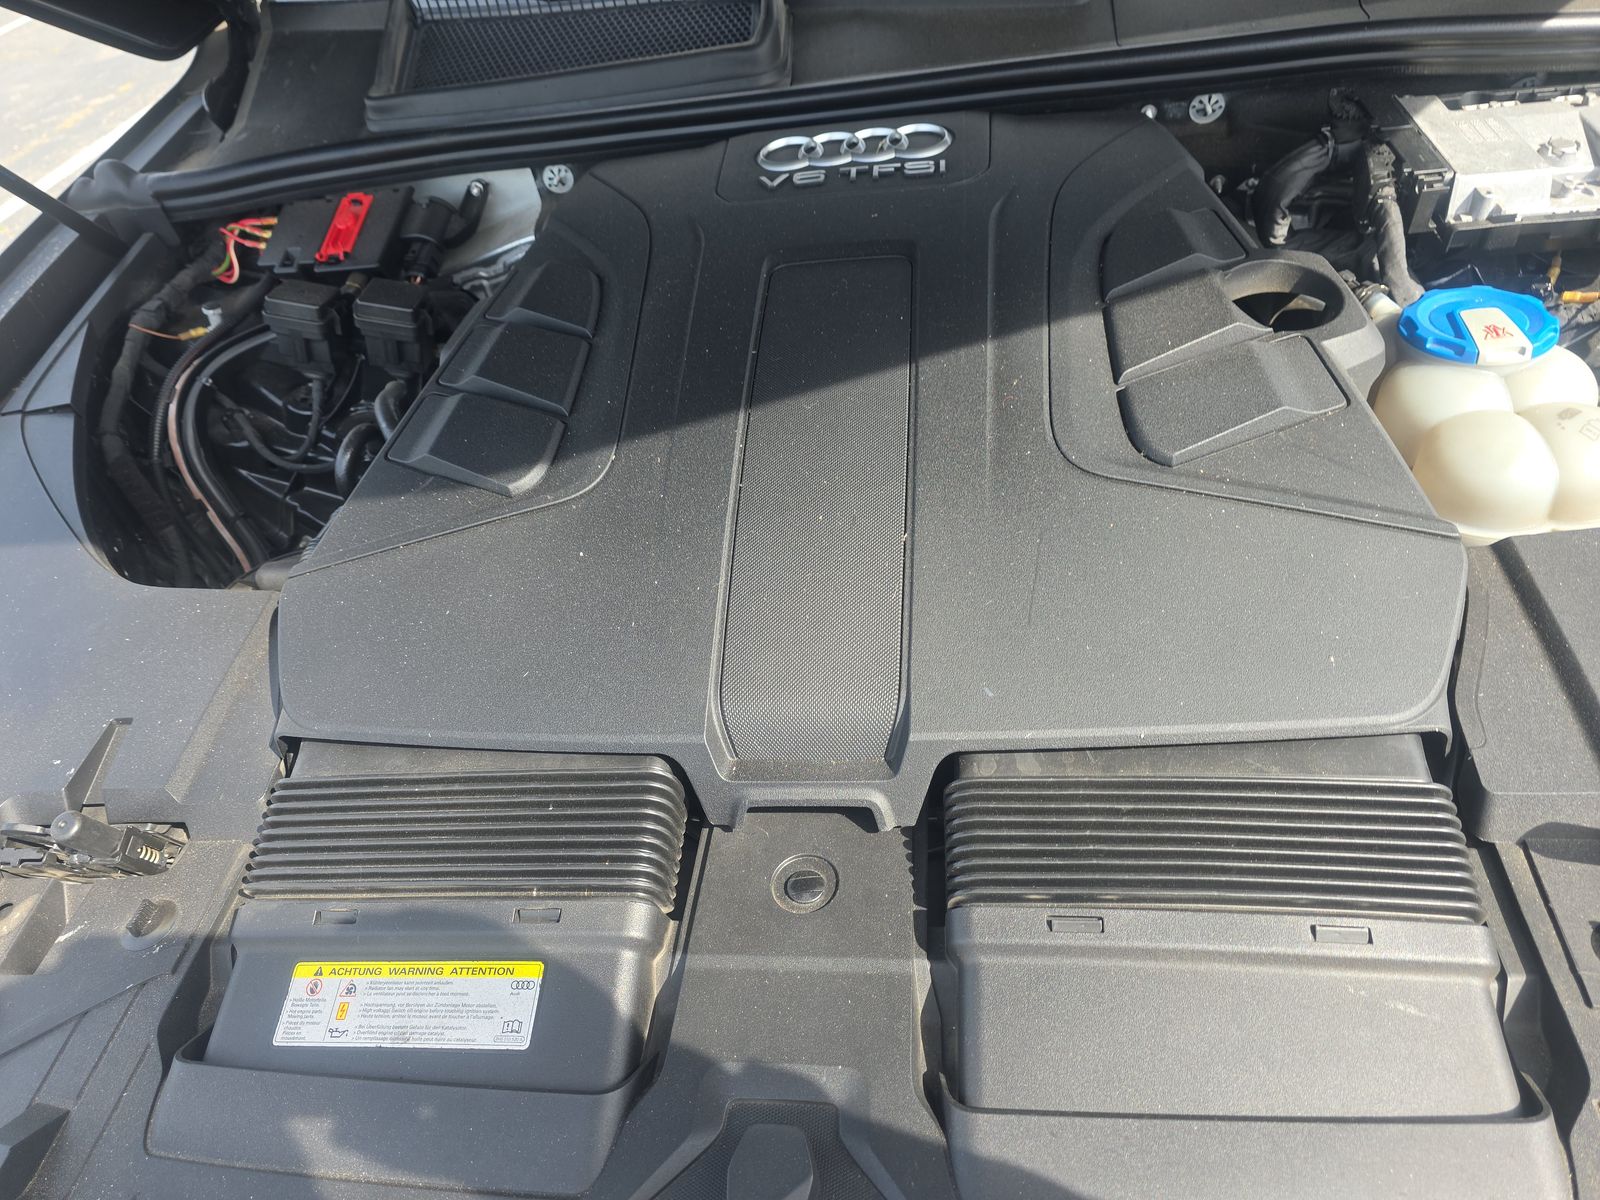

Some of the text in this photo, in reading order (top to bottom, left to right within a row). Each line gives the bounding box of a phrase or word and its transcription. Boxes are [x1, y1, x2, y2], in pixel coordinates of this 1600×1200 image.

[758, 159, 946, 190] V6 TFSI
[328, 967, 515, 976] ACHTUNG WARNING ATTENTION
